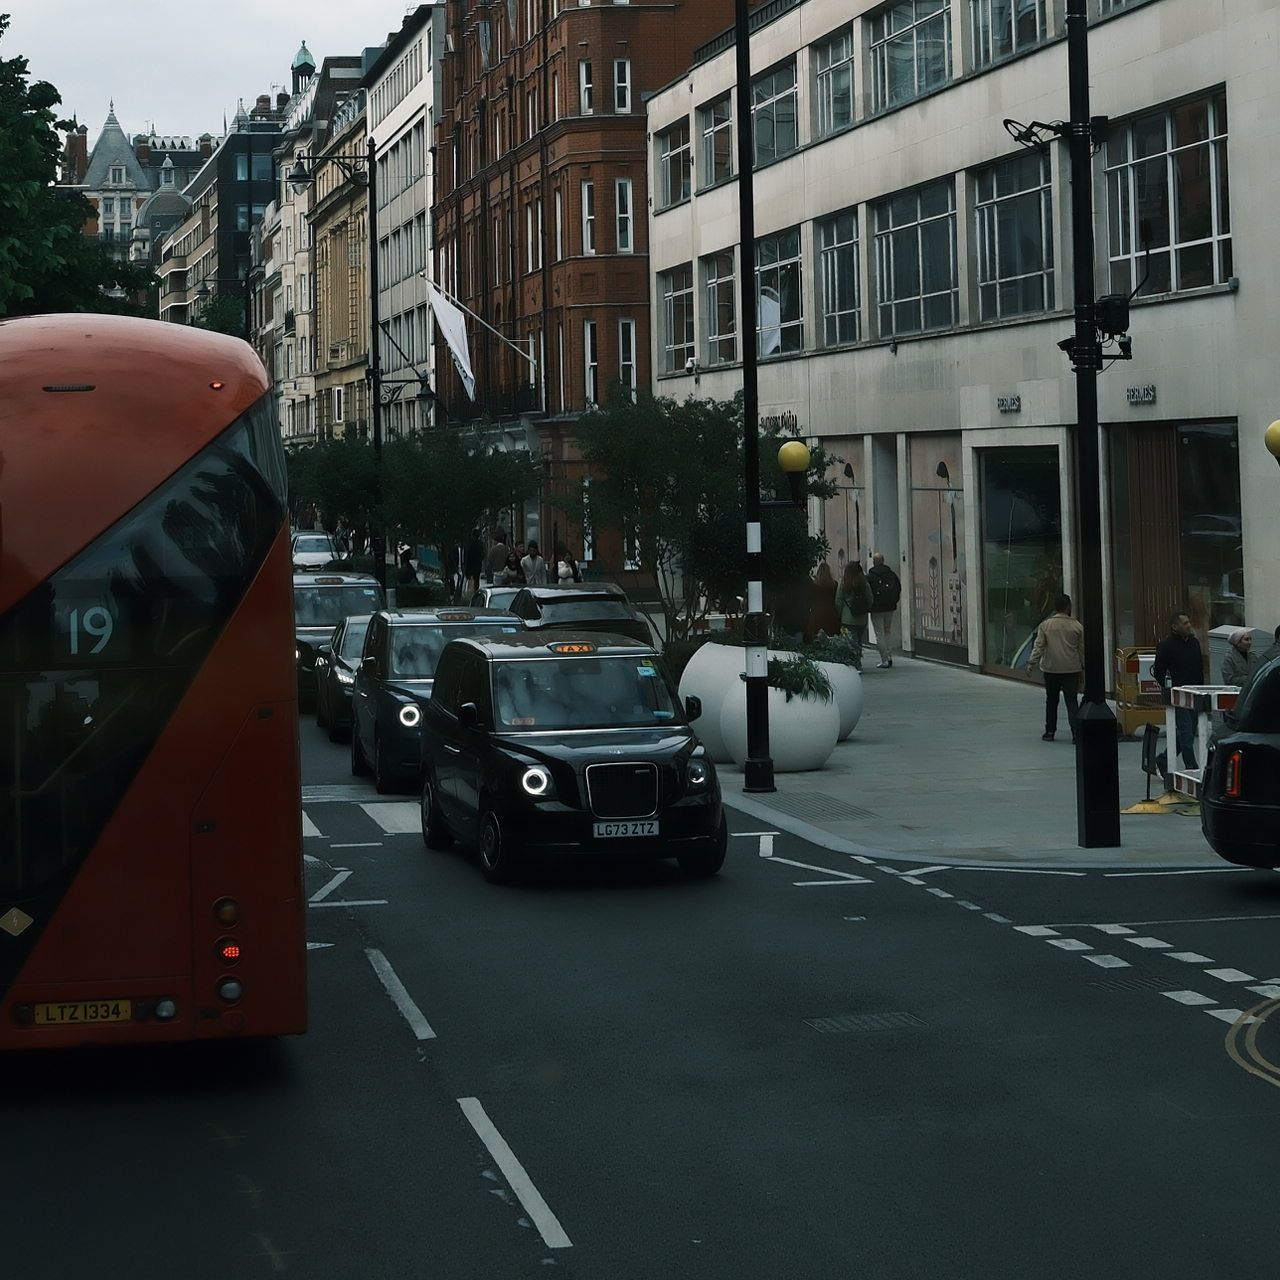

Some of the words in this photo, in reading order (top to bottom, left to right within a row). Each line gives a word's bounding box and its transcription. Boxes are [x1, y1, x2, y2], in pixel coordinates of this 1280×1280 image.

[70, 606, 114, 655] 19
[558, 644, 591, 652] TAXI
[597, 824, 628, 836] LG73
[632, 822, 654, 835] ZTZ
[46, 1005, 78, 1021] LTZ
[84, 1002, 121, 1020] 1334
